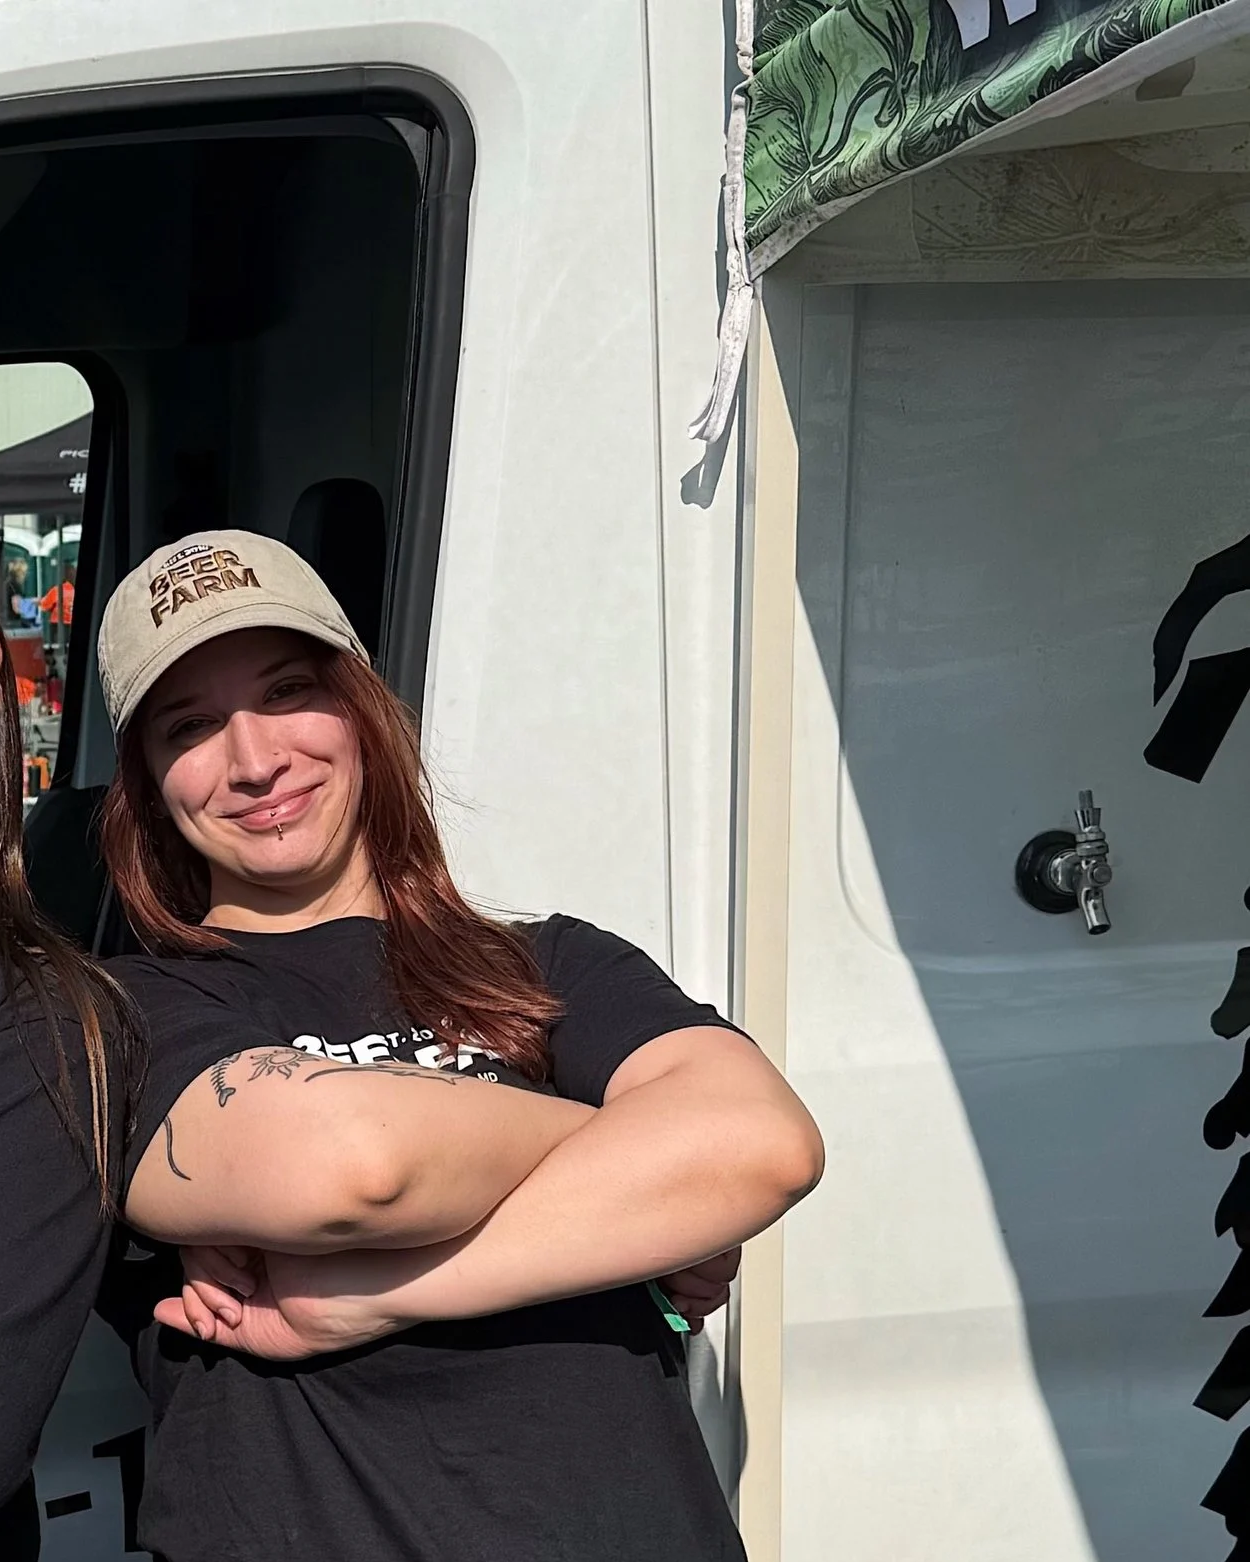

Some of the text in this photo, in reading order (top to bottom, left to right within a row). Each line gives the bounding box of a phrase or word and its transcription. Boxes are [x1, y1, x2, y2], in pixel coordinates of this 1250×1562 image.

[59, 449, 89, 459] PIC
[149, 549, 244, 599] BEER
[150, 567, 262, 629] FARM
